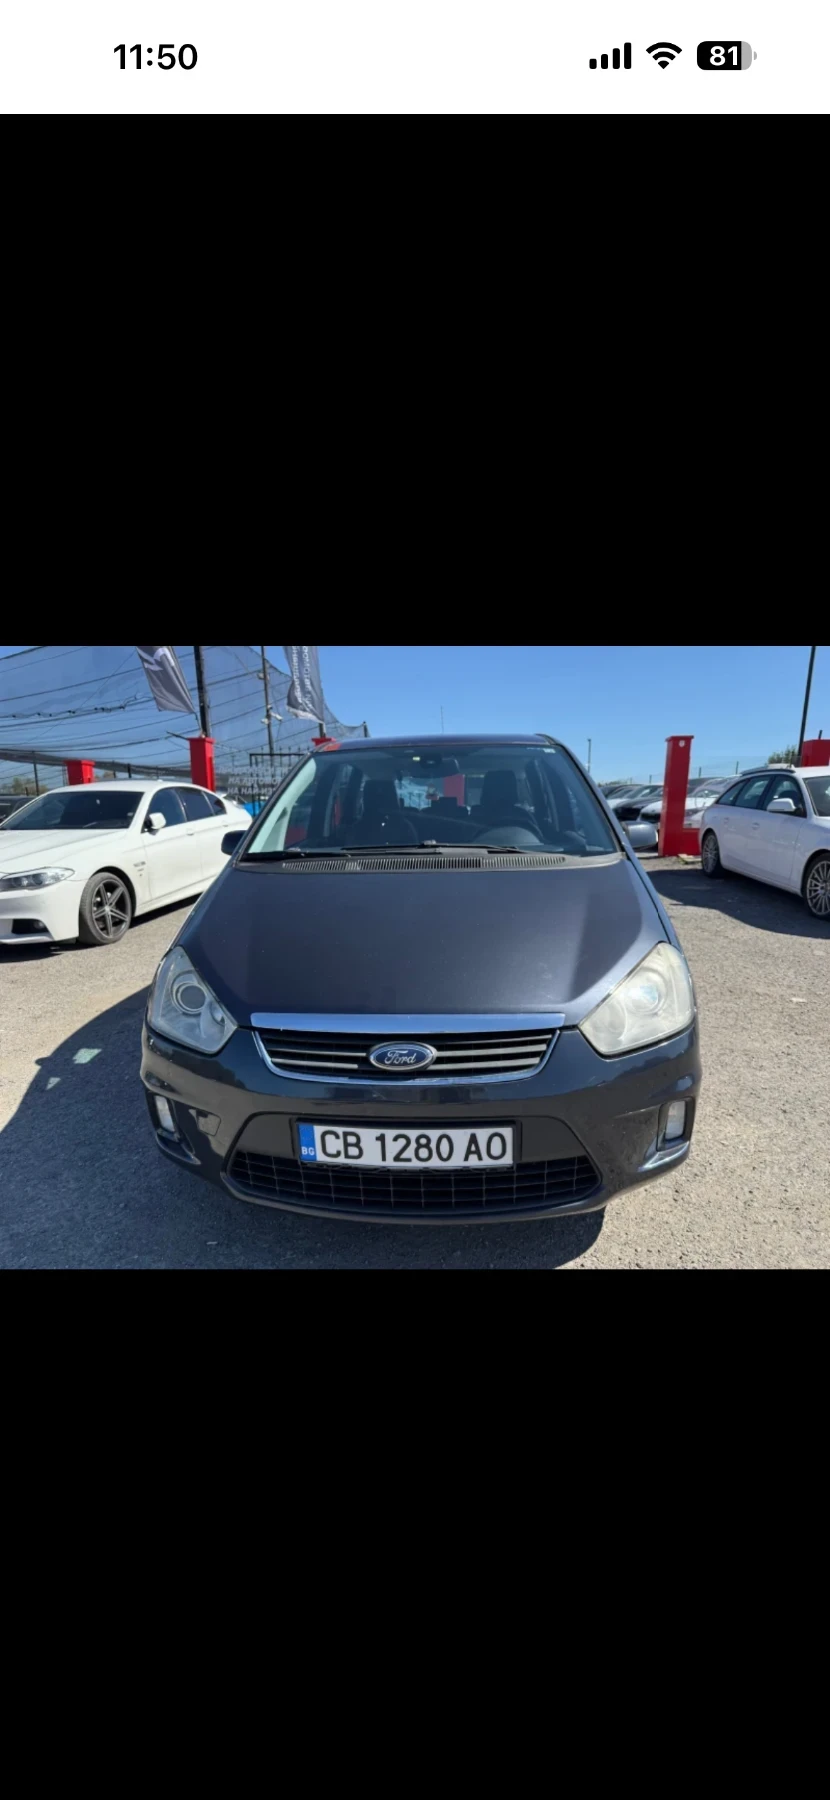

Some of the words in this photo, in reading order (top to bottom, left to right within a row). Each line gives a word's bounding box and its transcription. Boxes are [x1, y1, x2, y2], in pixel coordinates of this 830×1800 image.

[384, 1050, 417, 1064] Ford
[301, 1146, 315, 1156] BG
[320, 1130, 364, 1160] CB
[375, 1133, 454, 1162] 1280
[463, 1132, 507, 1161] AO
